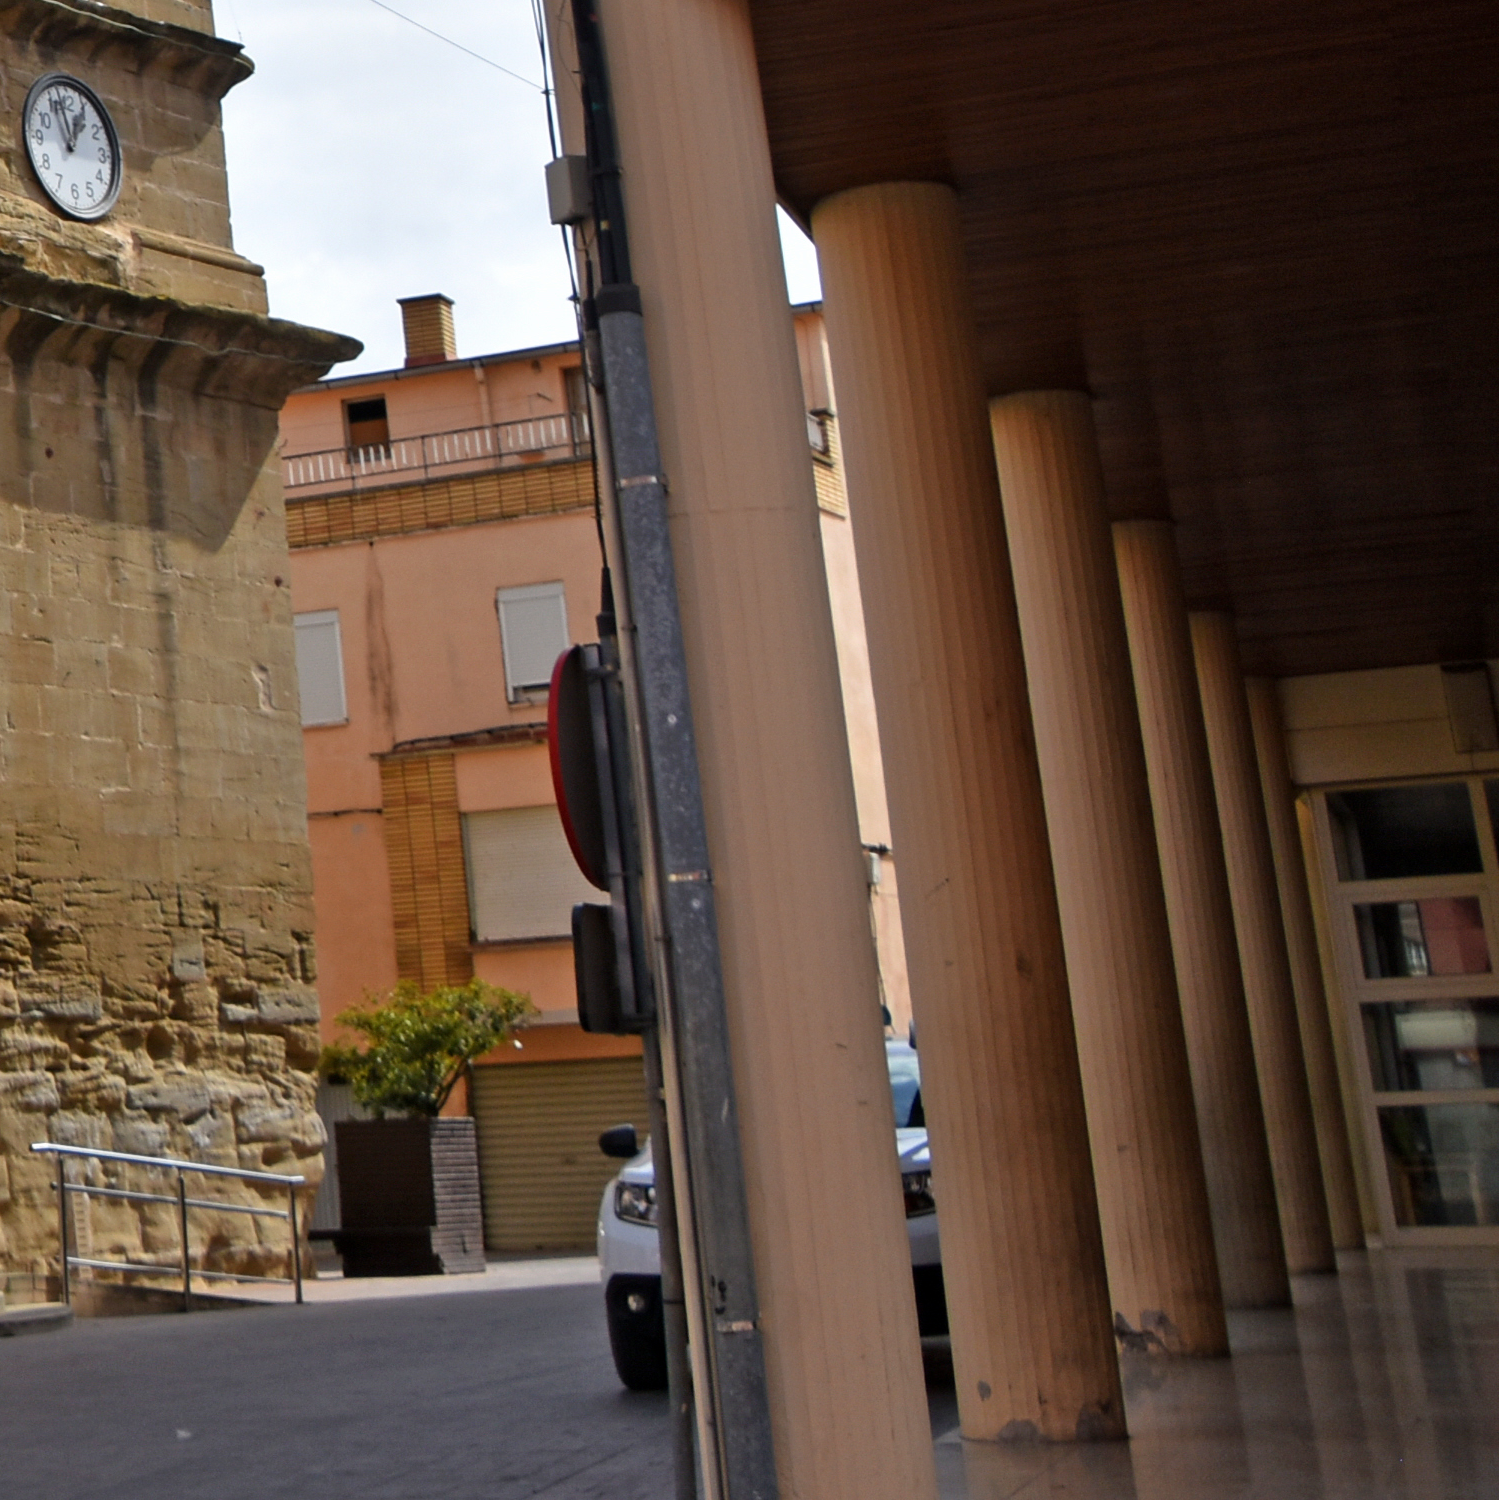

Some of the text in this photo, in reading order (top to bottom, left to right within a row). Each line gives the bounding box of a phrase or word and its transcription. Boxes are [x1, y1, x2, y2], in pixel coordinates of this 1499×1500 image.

[61, 95, 75, 113] 12
[39, 111, 51, 129] 10
[36, 129, 43, 146] 9
[91, 124, 100, 140] 2
[42, 153, 50, 170] 8
[98, 147, 107, 164] 3
[55, 173, 63, 189] 7
[96, 169, 103, 184] 4
[70, 183, 79, 200] 6
[86, 181, 94, 198] 5
